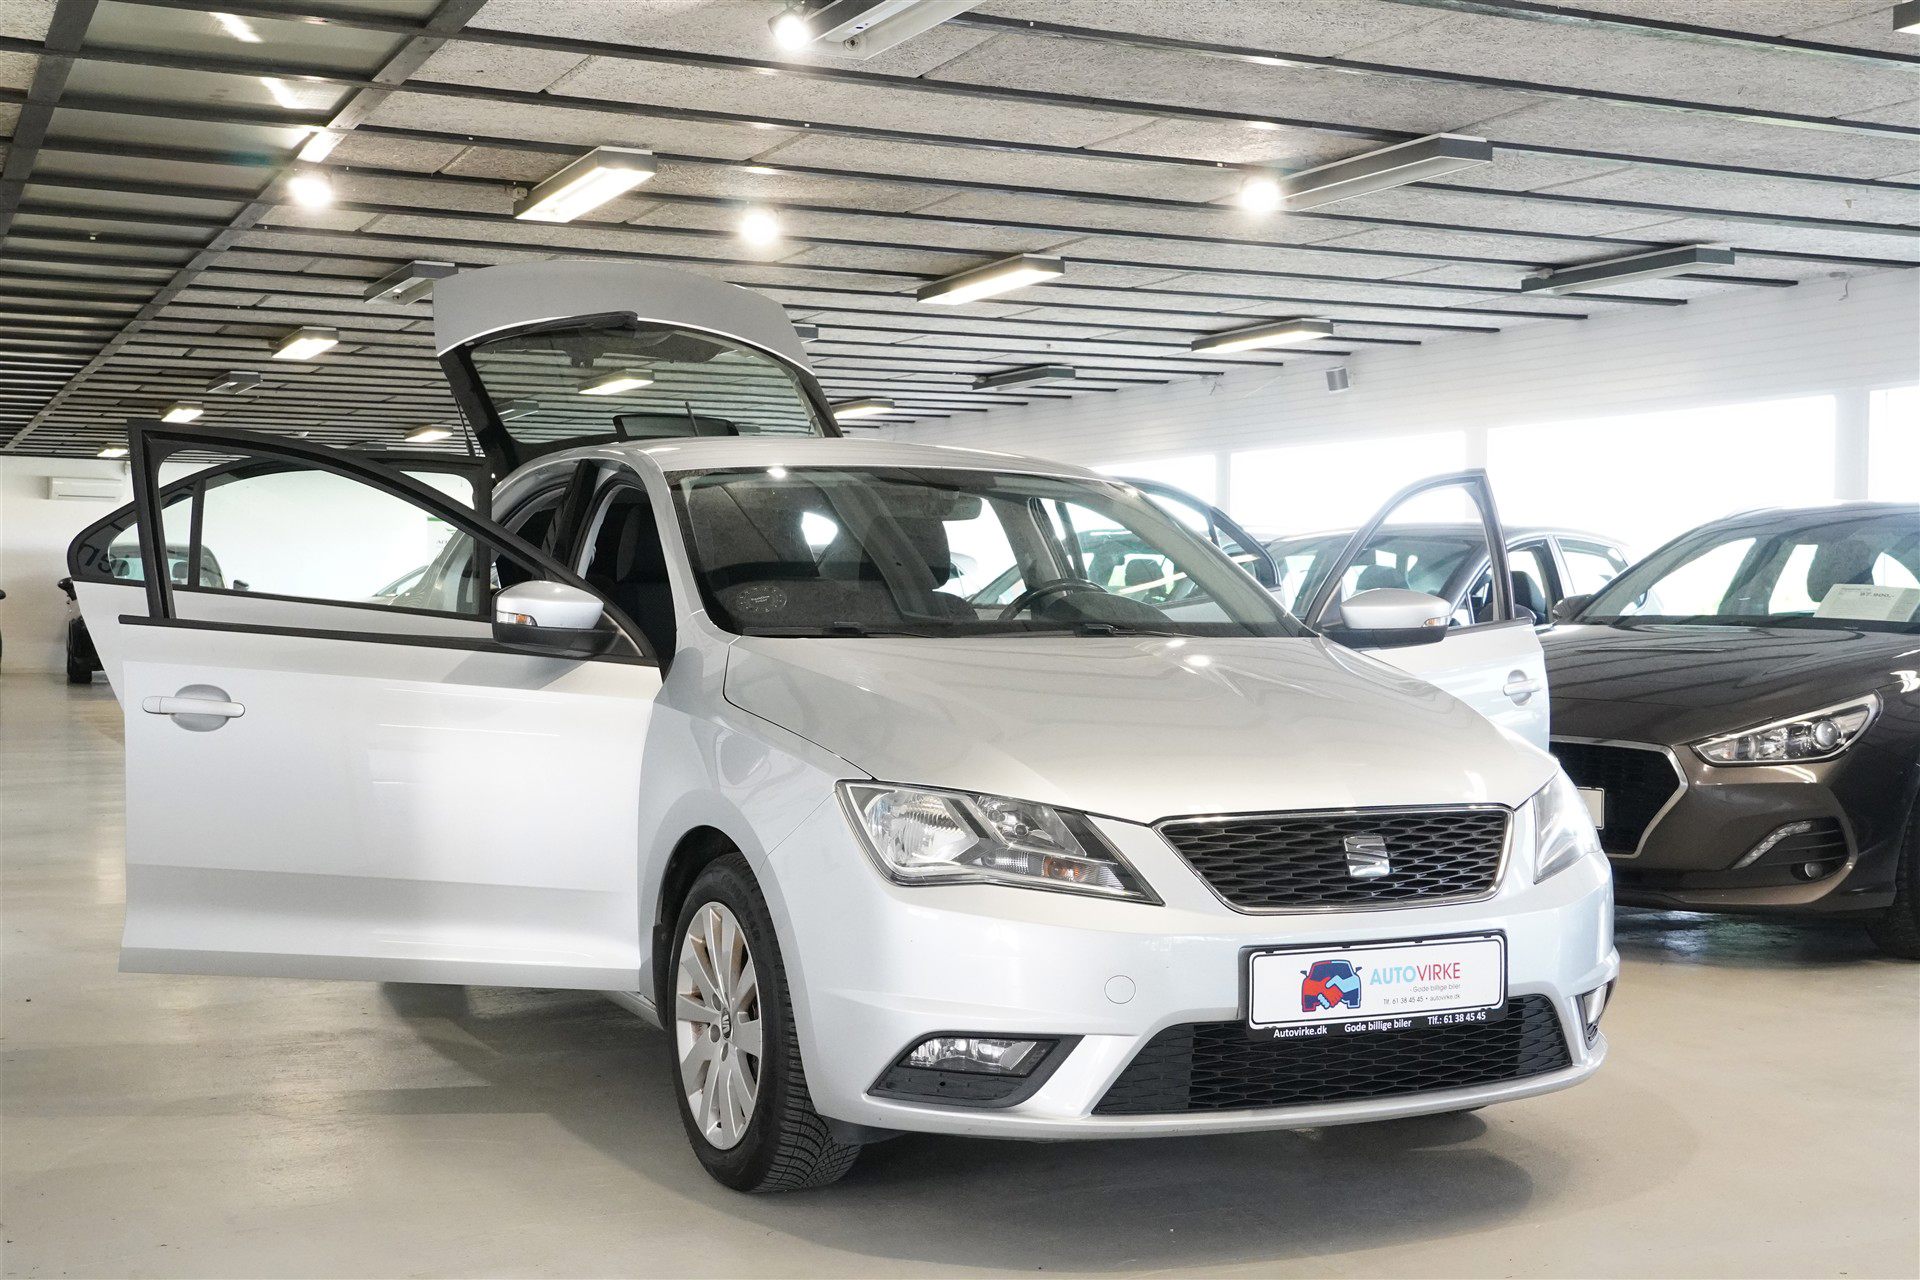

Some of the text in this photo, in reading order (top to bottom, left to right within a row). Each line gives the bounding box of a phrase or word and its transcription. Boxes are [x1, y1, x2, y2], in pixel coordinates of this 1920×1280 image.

[1369, 962, 1461, 985] AUTOVIRKE
[1273, 1012, 1486, 1038] Autovirke.dk Gode billige biler Tlf.: 61 38 45 45
